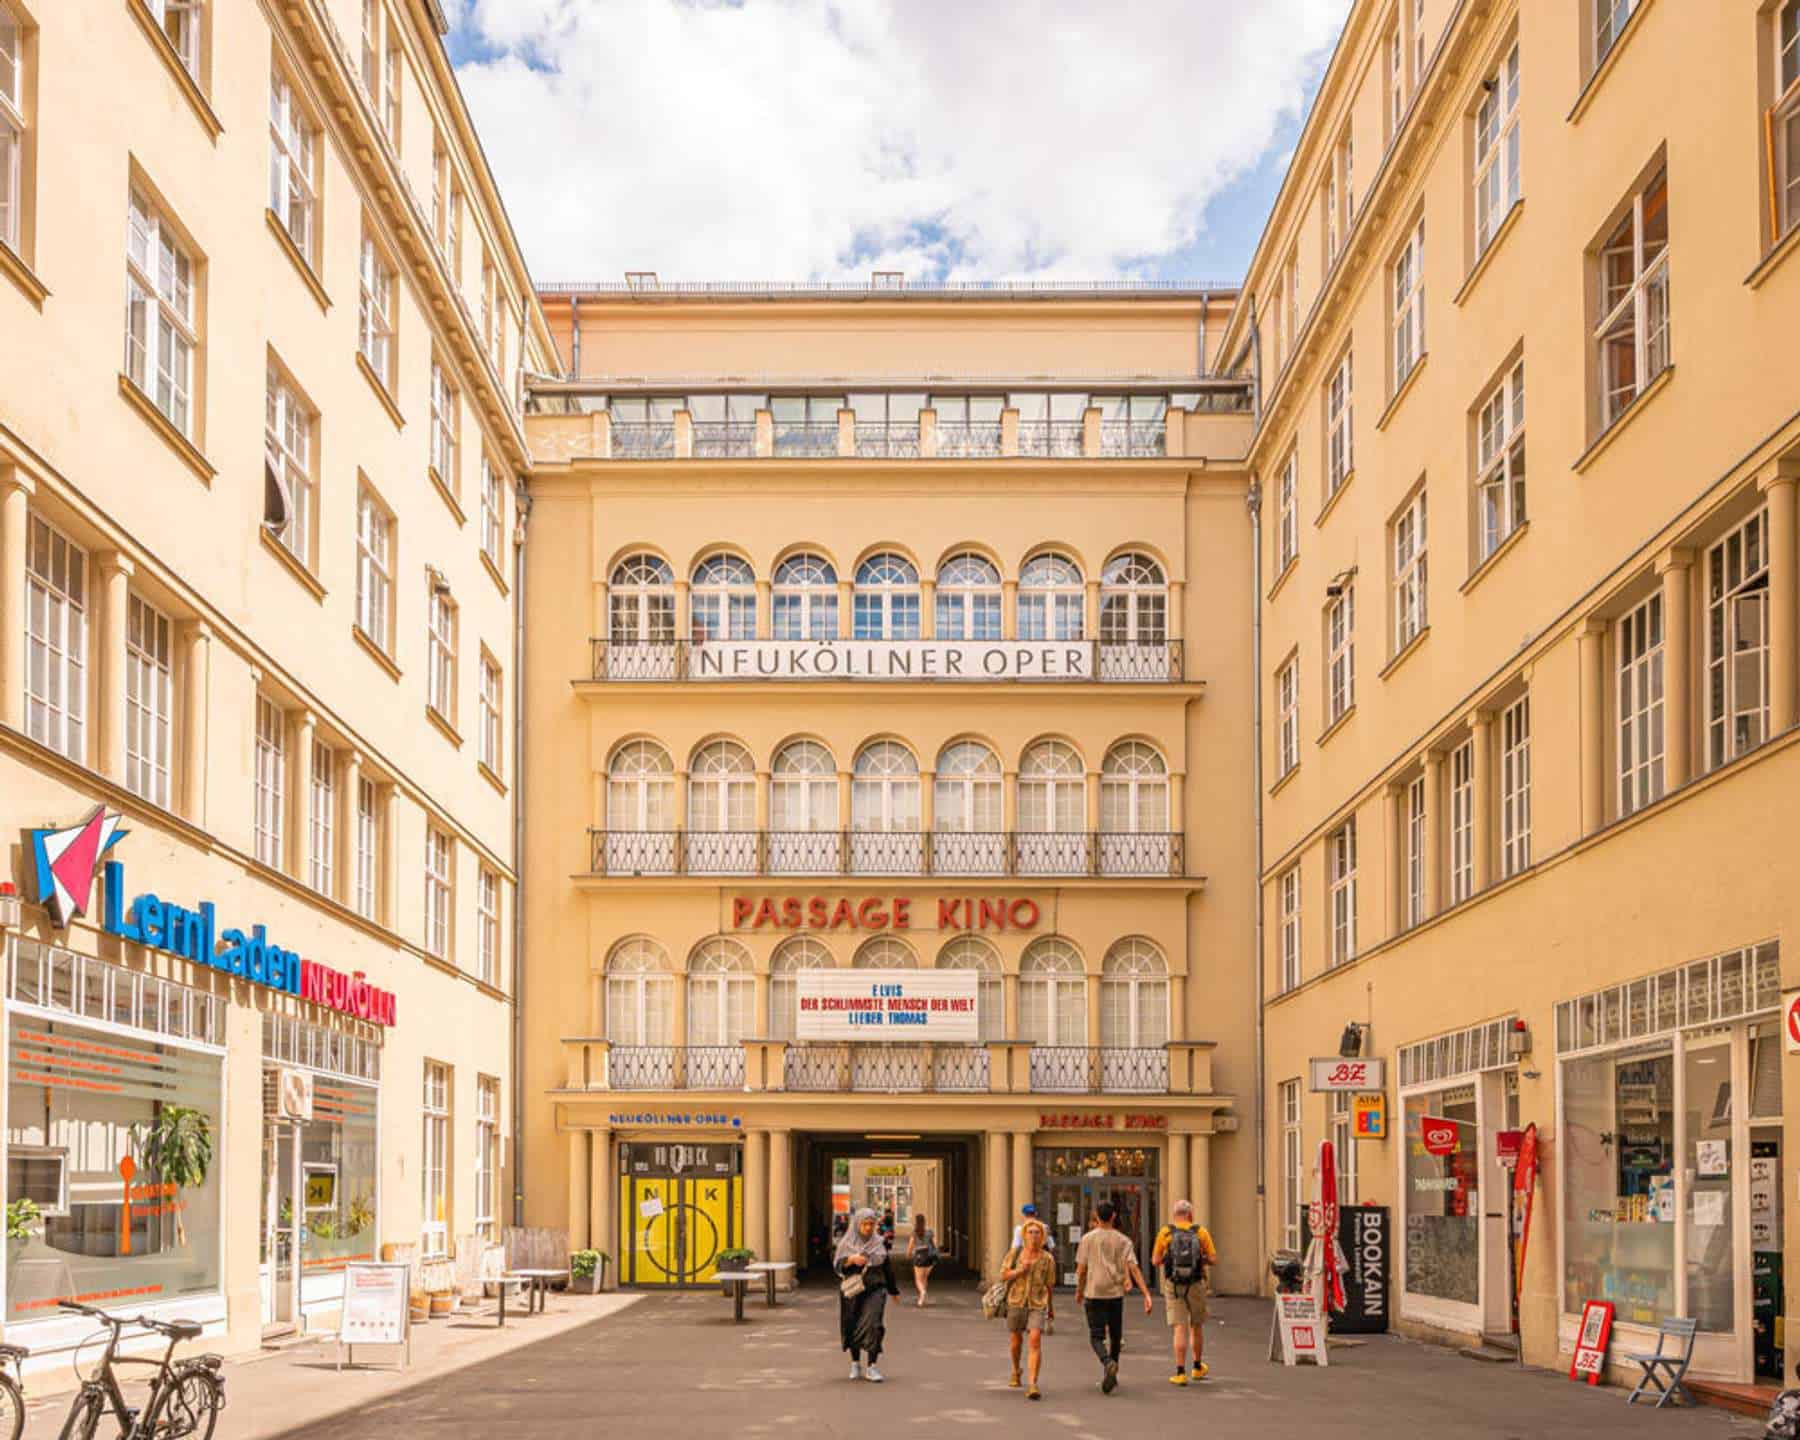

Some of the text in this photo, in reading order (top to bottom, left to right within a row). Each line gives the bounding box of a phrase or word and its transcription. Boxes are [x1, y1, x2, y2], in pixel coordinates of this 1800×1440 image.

[983, 649, 1082, 674] OPER
[732, 897, 1040, 930] PASSAGE KINO
[872, 984, 904, 997] ELVIS
[800, 998, 975, 1012] DER SCHLIMMSTE MENSCH DER WELT
[848, 1012, 928, 1025] LIEBER THOMAS
[1363, 1212, 1384, 1315] BOOKAIN
